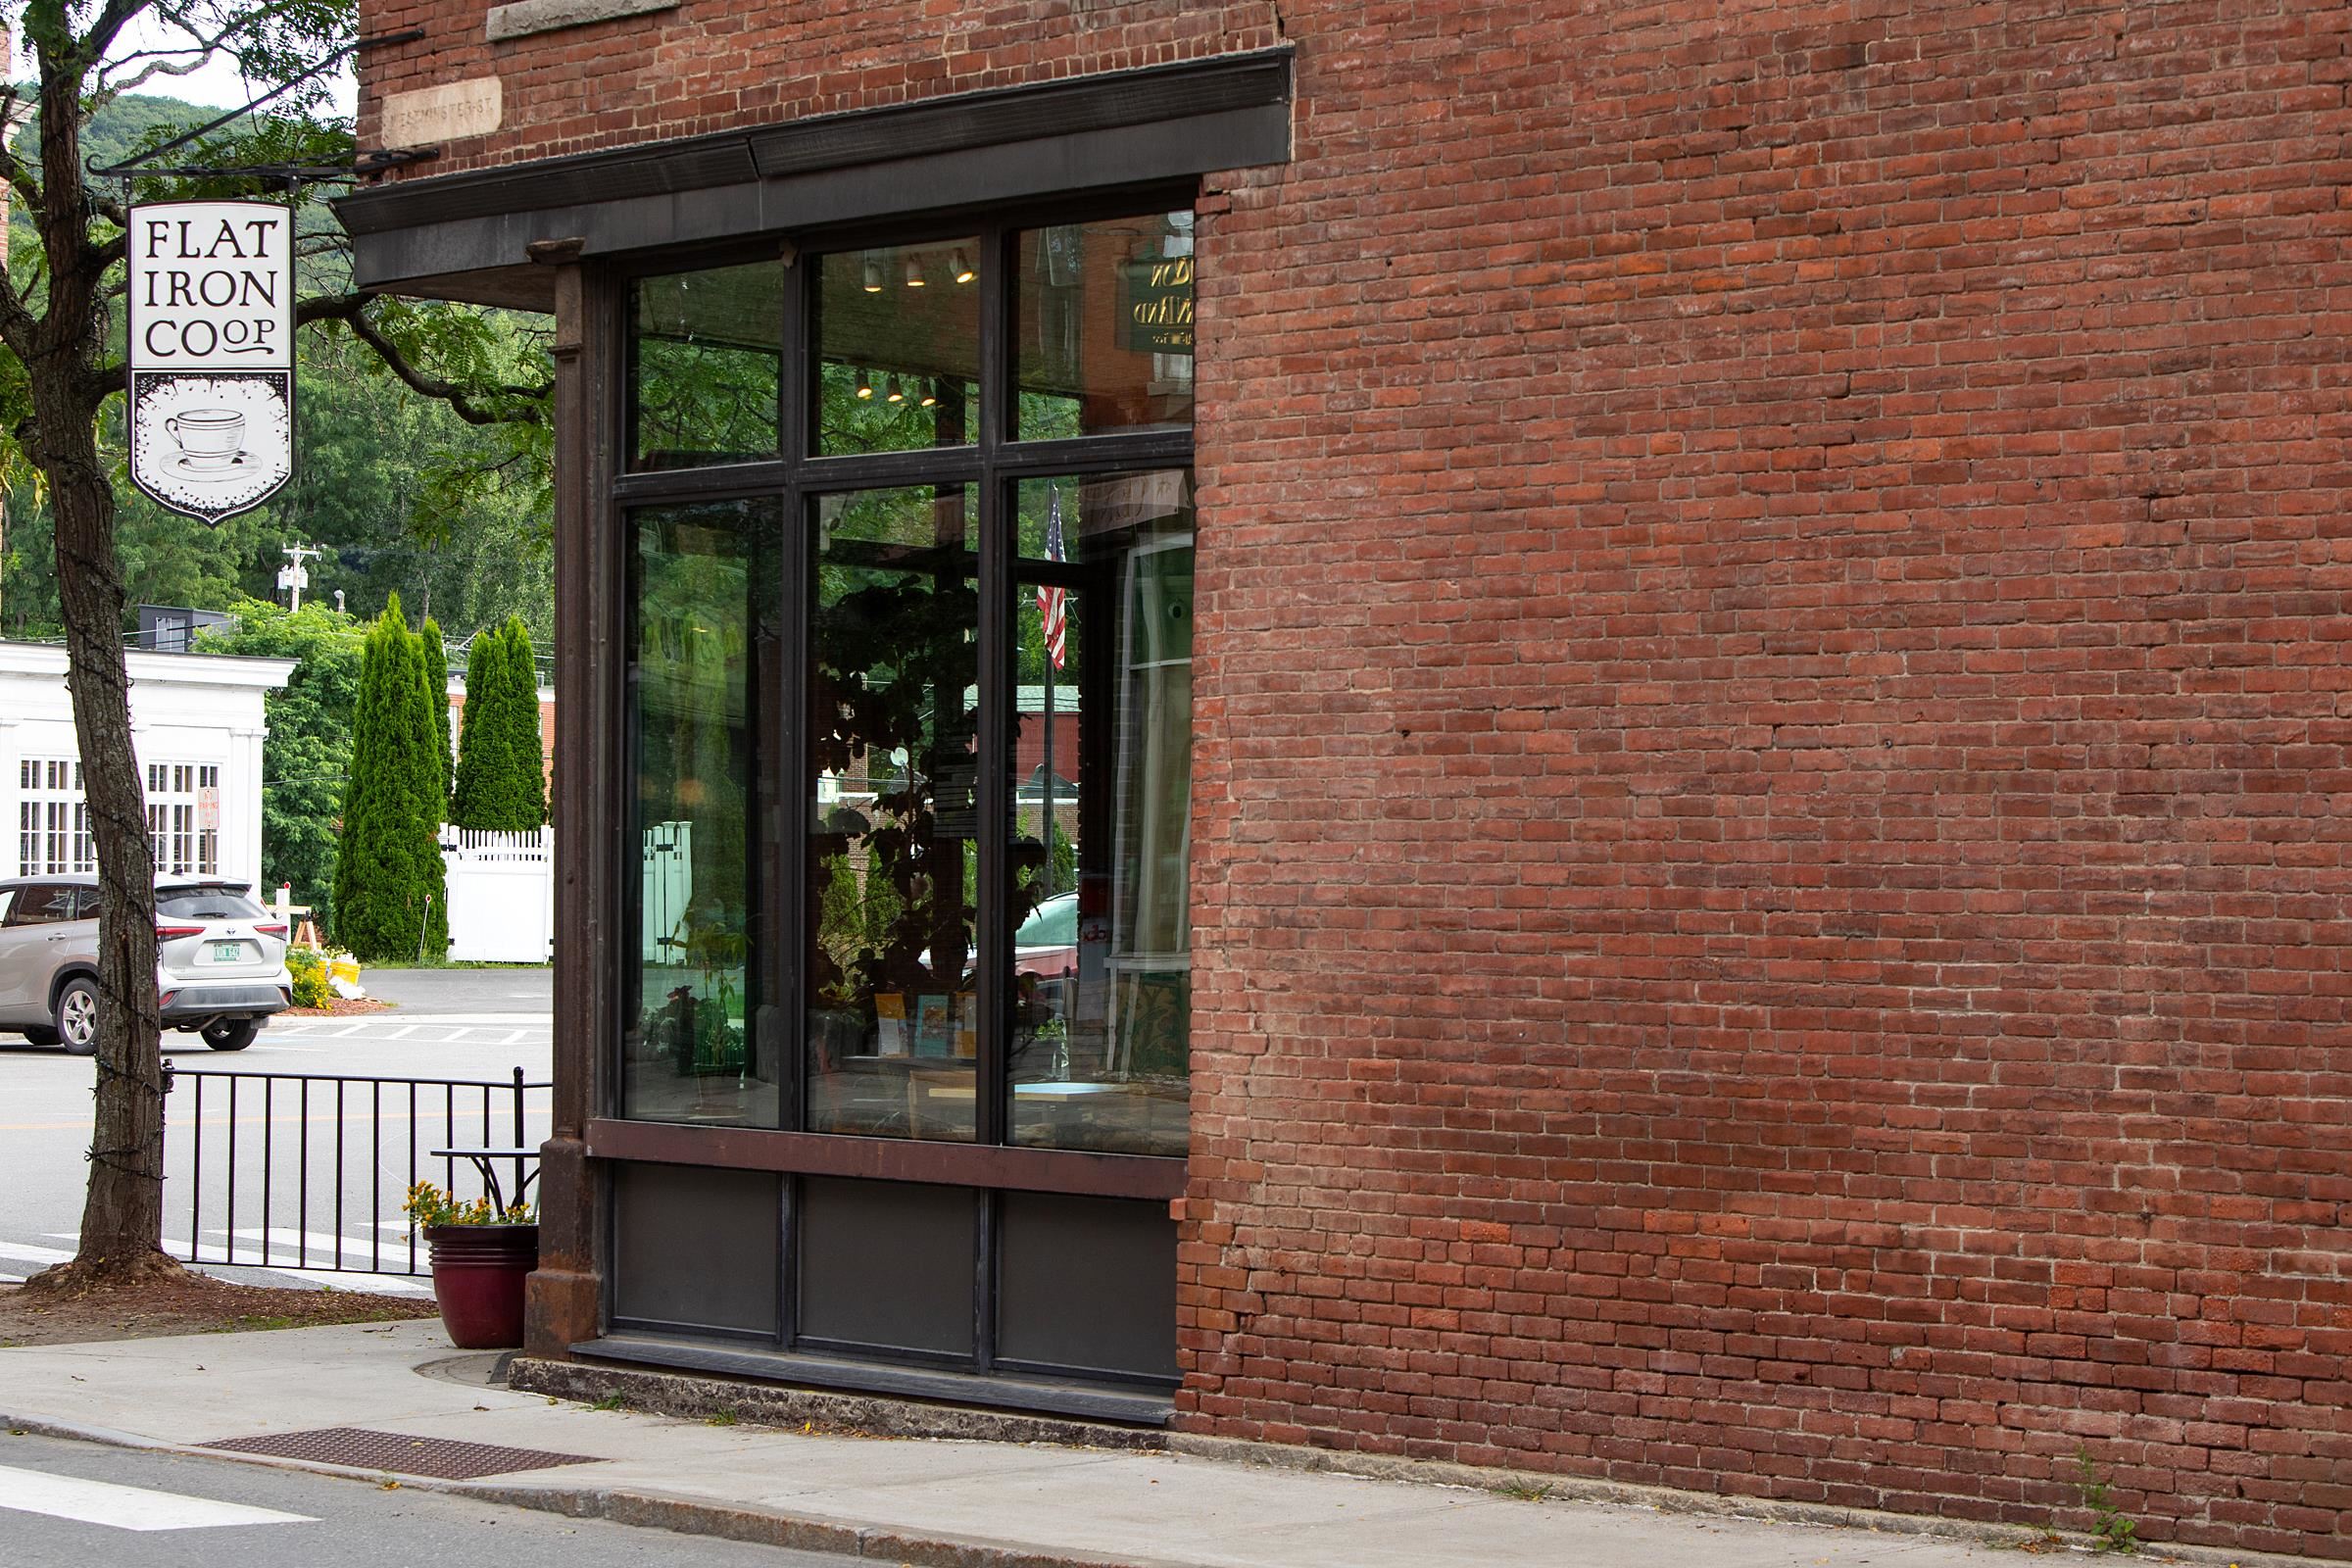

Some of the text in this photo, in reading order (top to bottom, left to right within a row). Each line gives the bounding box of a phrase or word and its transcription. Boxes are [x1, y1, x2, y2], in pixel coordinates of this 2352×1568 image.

[145, 219, 278, 259] FLAT
[144, 270, 278, 309] IRON
[145, 318, 275, 357] COOP
